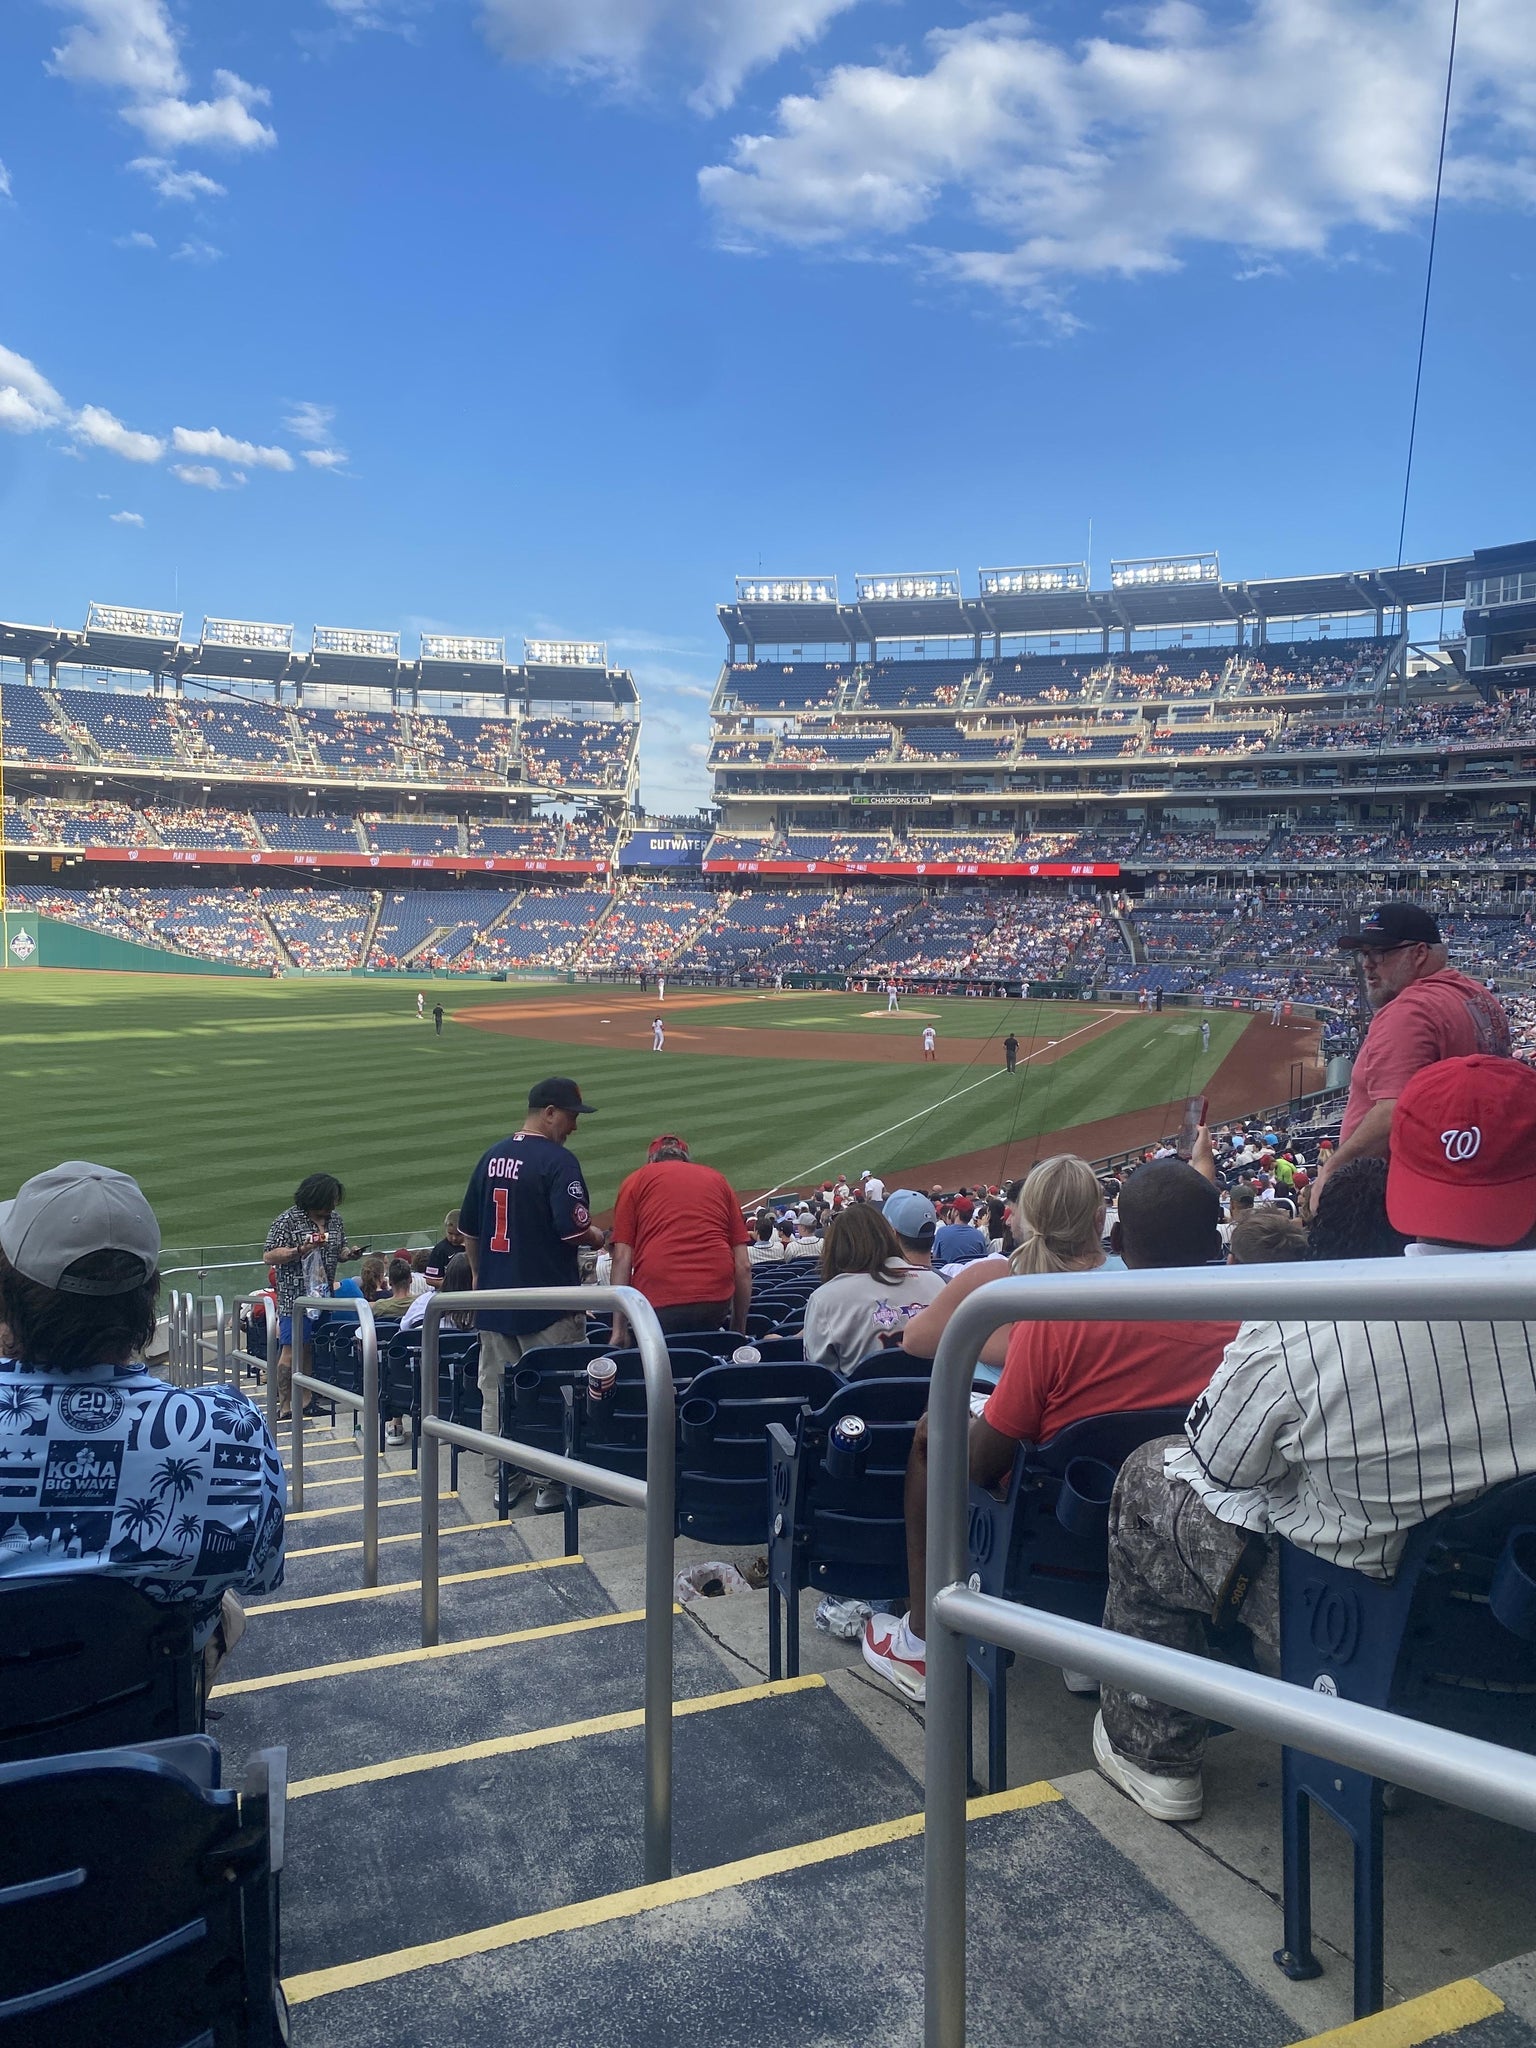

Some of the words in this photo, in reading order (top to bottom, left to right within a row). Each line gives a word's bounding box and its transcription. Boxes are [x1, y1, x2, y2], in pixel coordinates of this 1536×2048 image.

[1465, 743, 1503, 751] WASHINGTON
[650, 839, 708, 851] CUTWATER
[1169, 873, 1190, 881] PNC
[488, 1157, 524, 1180] GORE
[490, 1187, 511, 1253] 1
[78, 1390, 107, 1409] 20
[47, 1461, 116, 1479] KONA
[45, 1479, 72, 1490] BIG
[75, 1479, 117, 1490] WAVE
